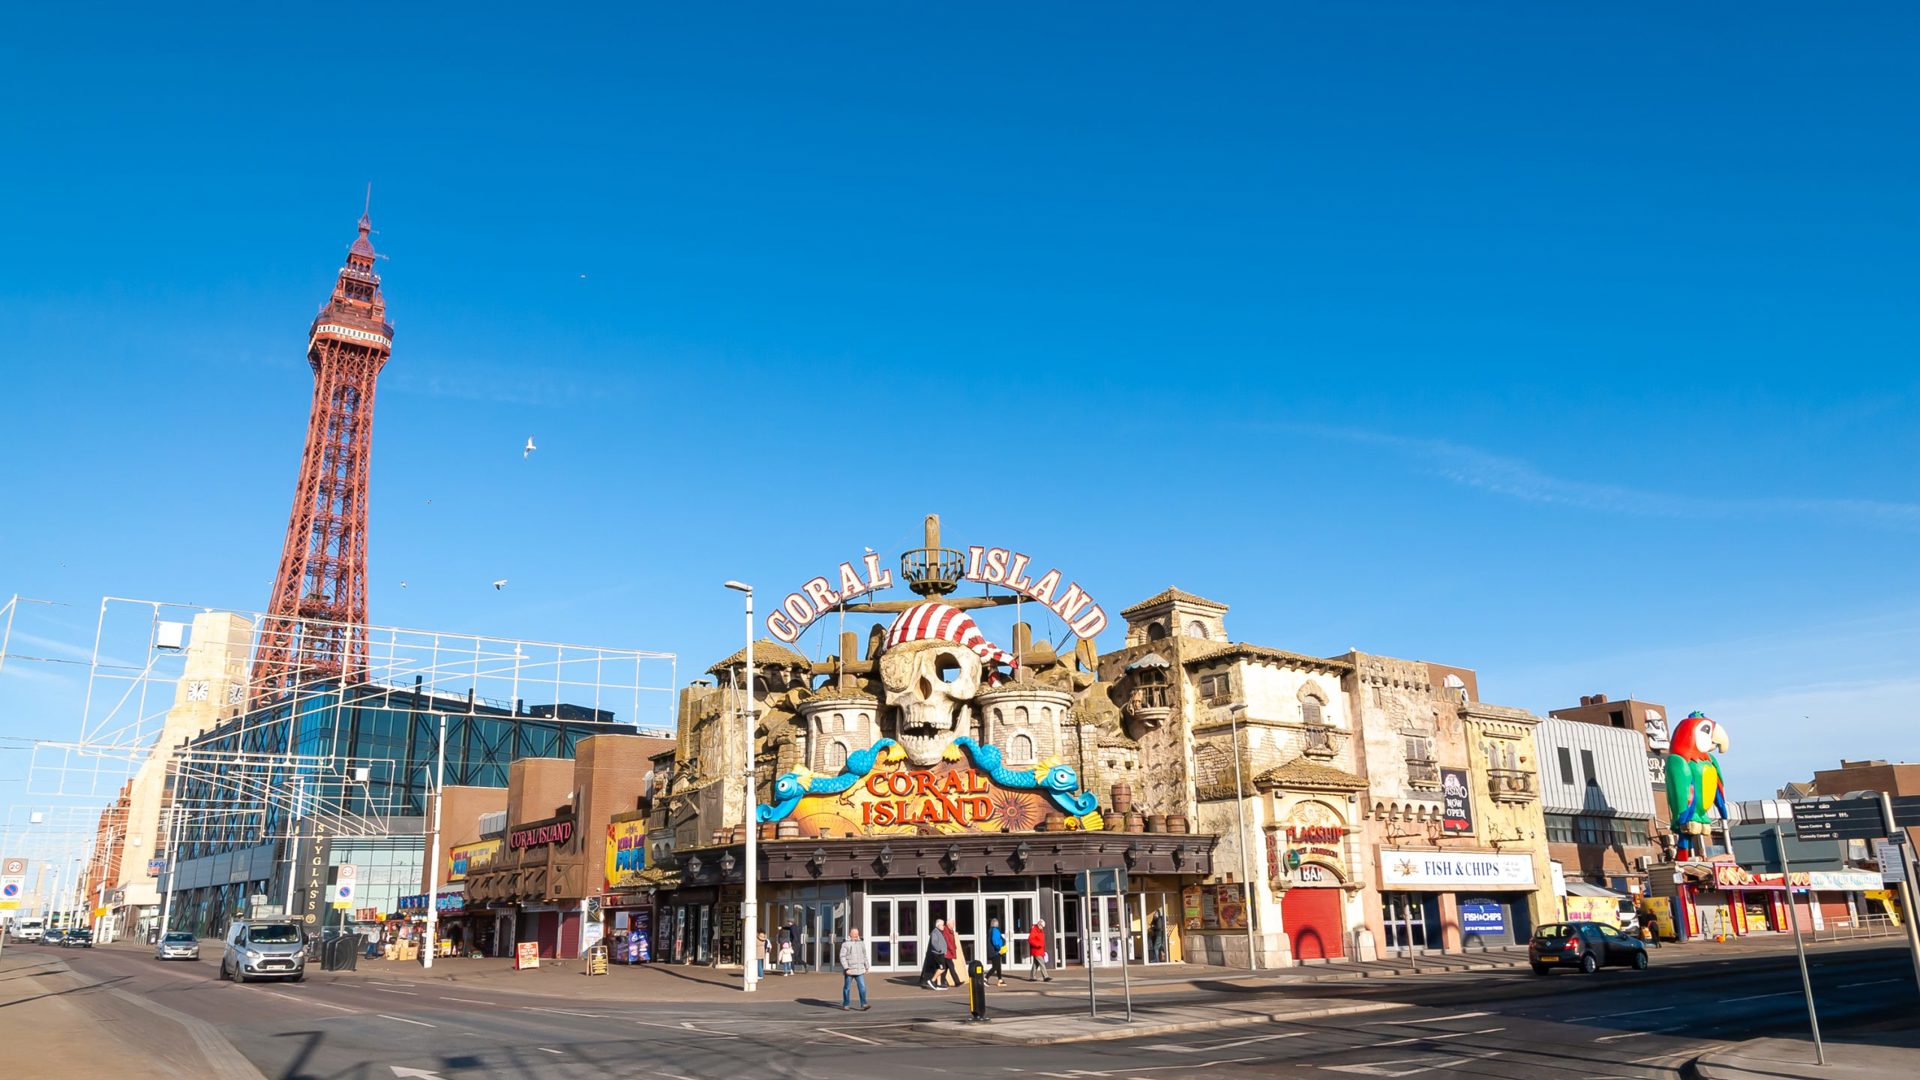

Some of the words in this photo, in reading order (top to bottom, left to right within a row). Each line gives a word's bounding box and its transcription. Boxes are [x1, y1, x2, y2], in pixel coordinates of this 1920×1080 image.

[766, 552, 893, 643] CORAL
[966, 545, 1108, 640] ISLAND
[865, 768, 990, 798] CORAL
[861, 796, 996, 827] ISLAND
[1446, 798, 1463, 808] NOW
[1446, 808, 1467, 820] OPEN
[511, 830, 538, 849] CORAL
[538, 821, 571, 843] ISLAND
[1286, 825, 1344, 845] FLAGSHIP
[308, 824, 325, 910] SPYGLASS
[1425, 861, 1452, 876] FISH
[1455, 861, 1464, 876] &
[1465, 861, 1500, 877] CHIPS
[1463, 912, 1479, 922] FISH
[1482, 912, 1502, 922] CHIPS
